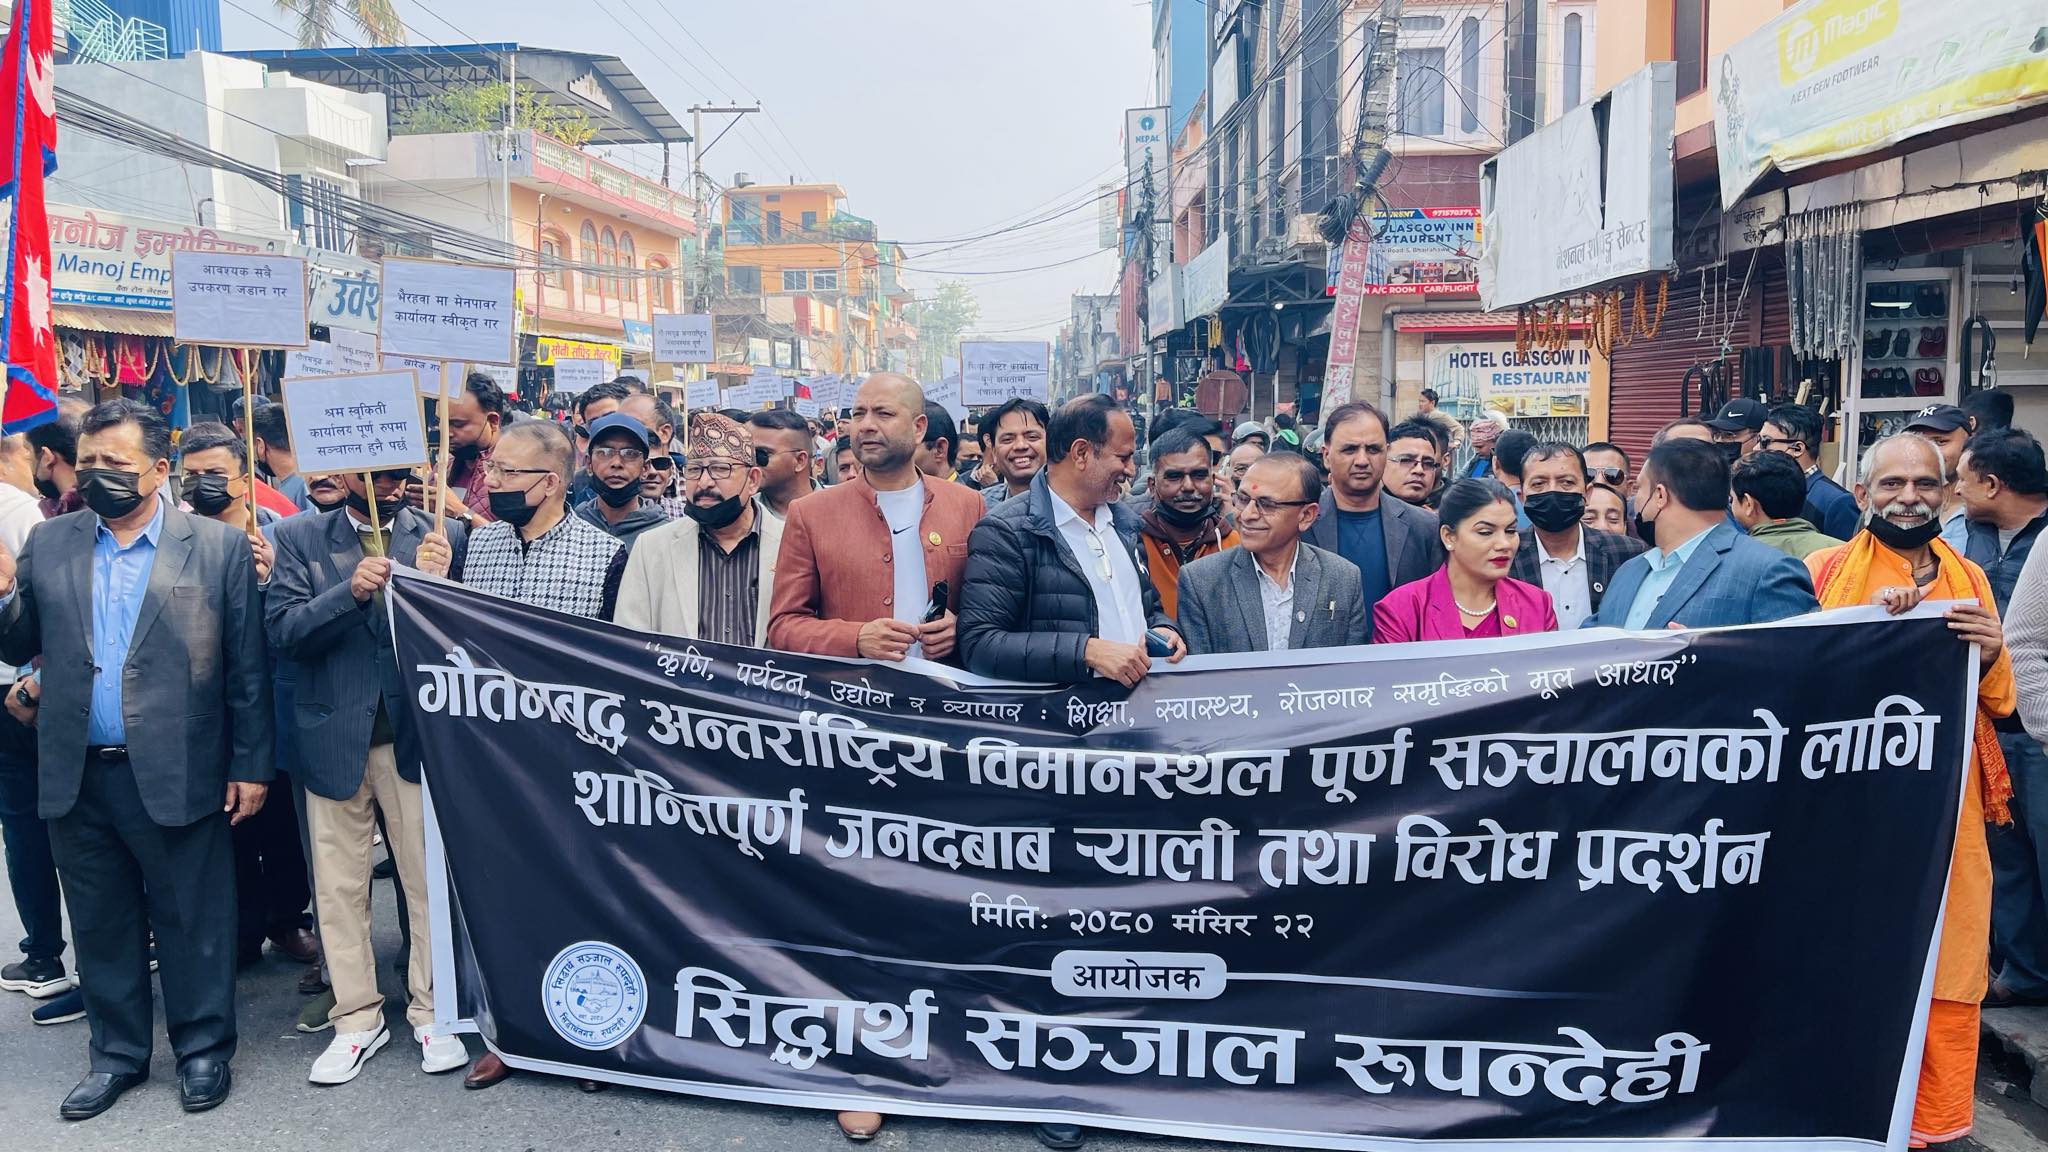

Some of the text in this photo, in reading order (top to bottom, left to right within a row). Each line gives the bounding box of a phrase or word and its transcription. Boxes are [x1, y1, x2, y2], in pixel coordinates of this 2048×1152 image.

[1790, 55, 1880, 105] NEXT GEN FOOTWEAR
[1380, 223, 1446, 233] GLASGOW
[1451, 223, 1474, 231] INN
[58, 253, 125, 281] Manoj
[203, 265, 249, 278] आवश्यक
[188, 283, 288, 297] उपकरण जडान गर
[398, 288, 497, 310] भैरहवा मा मेनपावर
[1371, 286, 1388, 294] A/C
[1424, 284, 1474, 293] CAR/FLIGHT
[394, 309, 499, 330] कार्यालय स्वीकृत गर
[1450, 352, 1497, 368] HOTEL
[1502, 350, 1574, 367] GLASGOW
[1492, 371, 1590, 386] RESTAURAN
[325, 407, 344, 418] श्रम
[309, 421, 407, 439] कार्यालय पूर्ण रुपमा
[317, 437, 408, 456] सञ्चालन हुनै पर्छ
[737, 659, 811, 699] पर्यटन,
[830, 677, 894, 709] उद्योग
[908, 696, 927, 713] र
[942, 700, 1024, 721] व्यापार
[1067, 696, 1136, 728] शिक्षा,
[1156, 694, 1260, 723] स्वास्थ्य,
[1279, 683, 1375, 715] रोजगार
[1392, 669, 1510, 706] समृद्धिको
[1528, 669, 1575, 697] मूल
[416, 645, 628, 755] गौतमबुद्ध
[966, 736, 1290, 800] विमानस्थल
[1310, 727, 1414, 803] पूर्ण
[1430, 708, 1789, 791] सञ्चालनको
[1800, 694, 1941, 780] लागि
[573, 769, 808, 861] शान्तिपूर्ण
[825, 804, 1055, 873] जनदबाब
[1258, 829, 1376, 888] तथा
[1394, 814, 1558, 884] विरोध
[1577, 818, 1771, 894] प्रदर्शन
[1069, 908, 1154, 937] २०८०
[1172, 907, 1258, 936] मंसिर
[1273, 913, 1315, 939] २२
[1073, 959, 1205, 992] आयोजक
[674, 967, 939, 1070] सिद्धार्थ
[965, 1009, 1305, 1085] सञ्जाल
